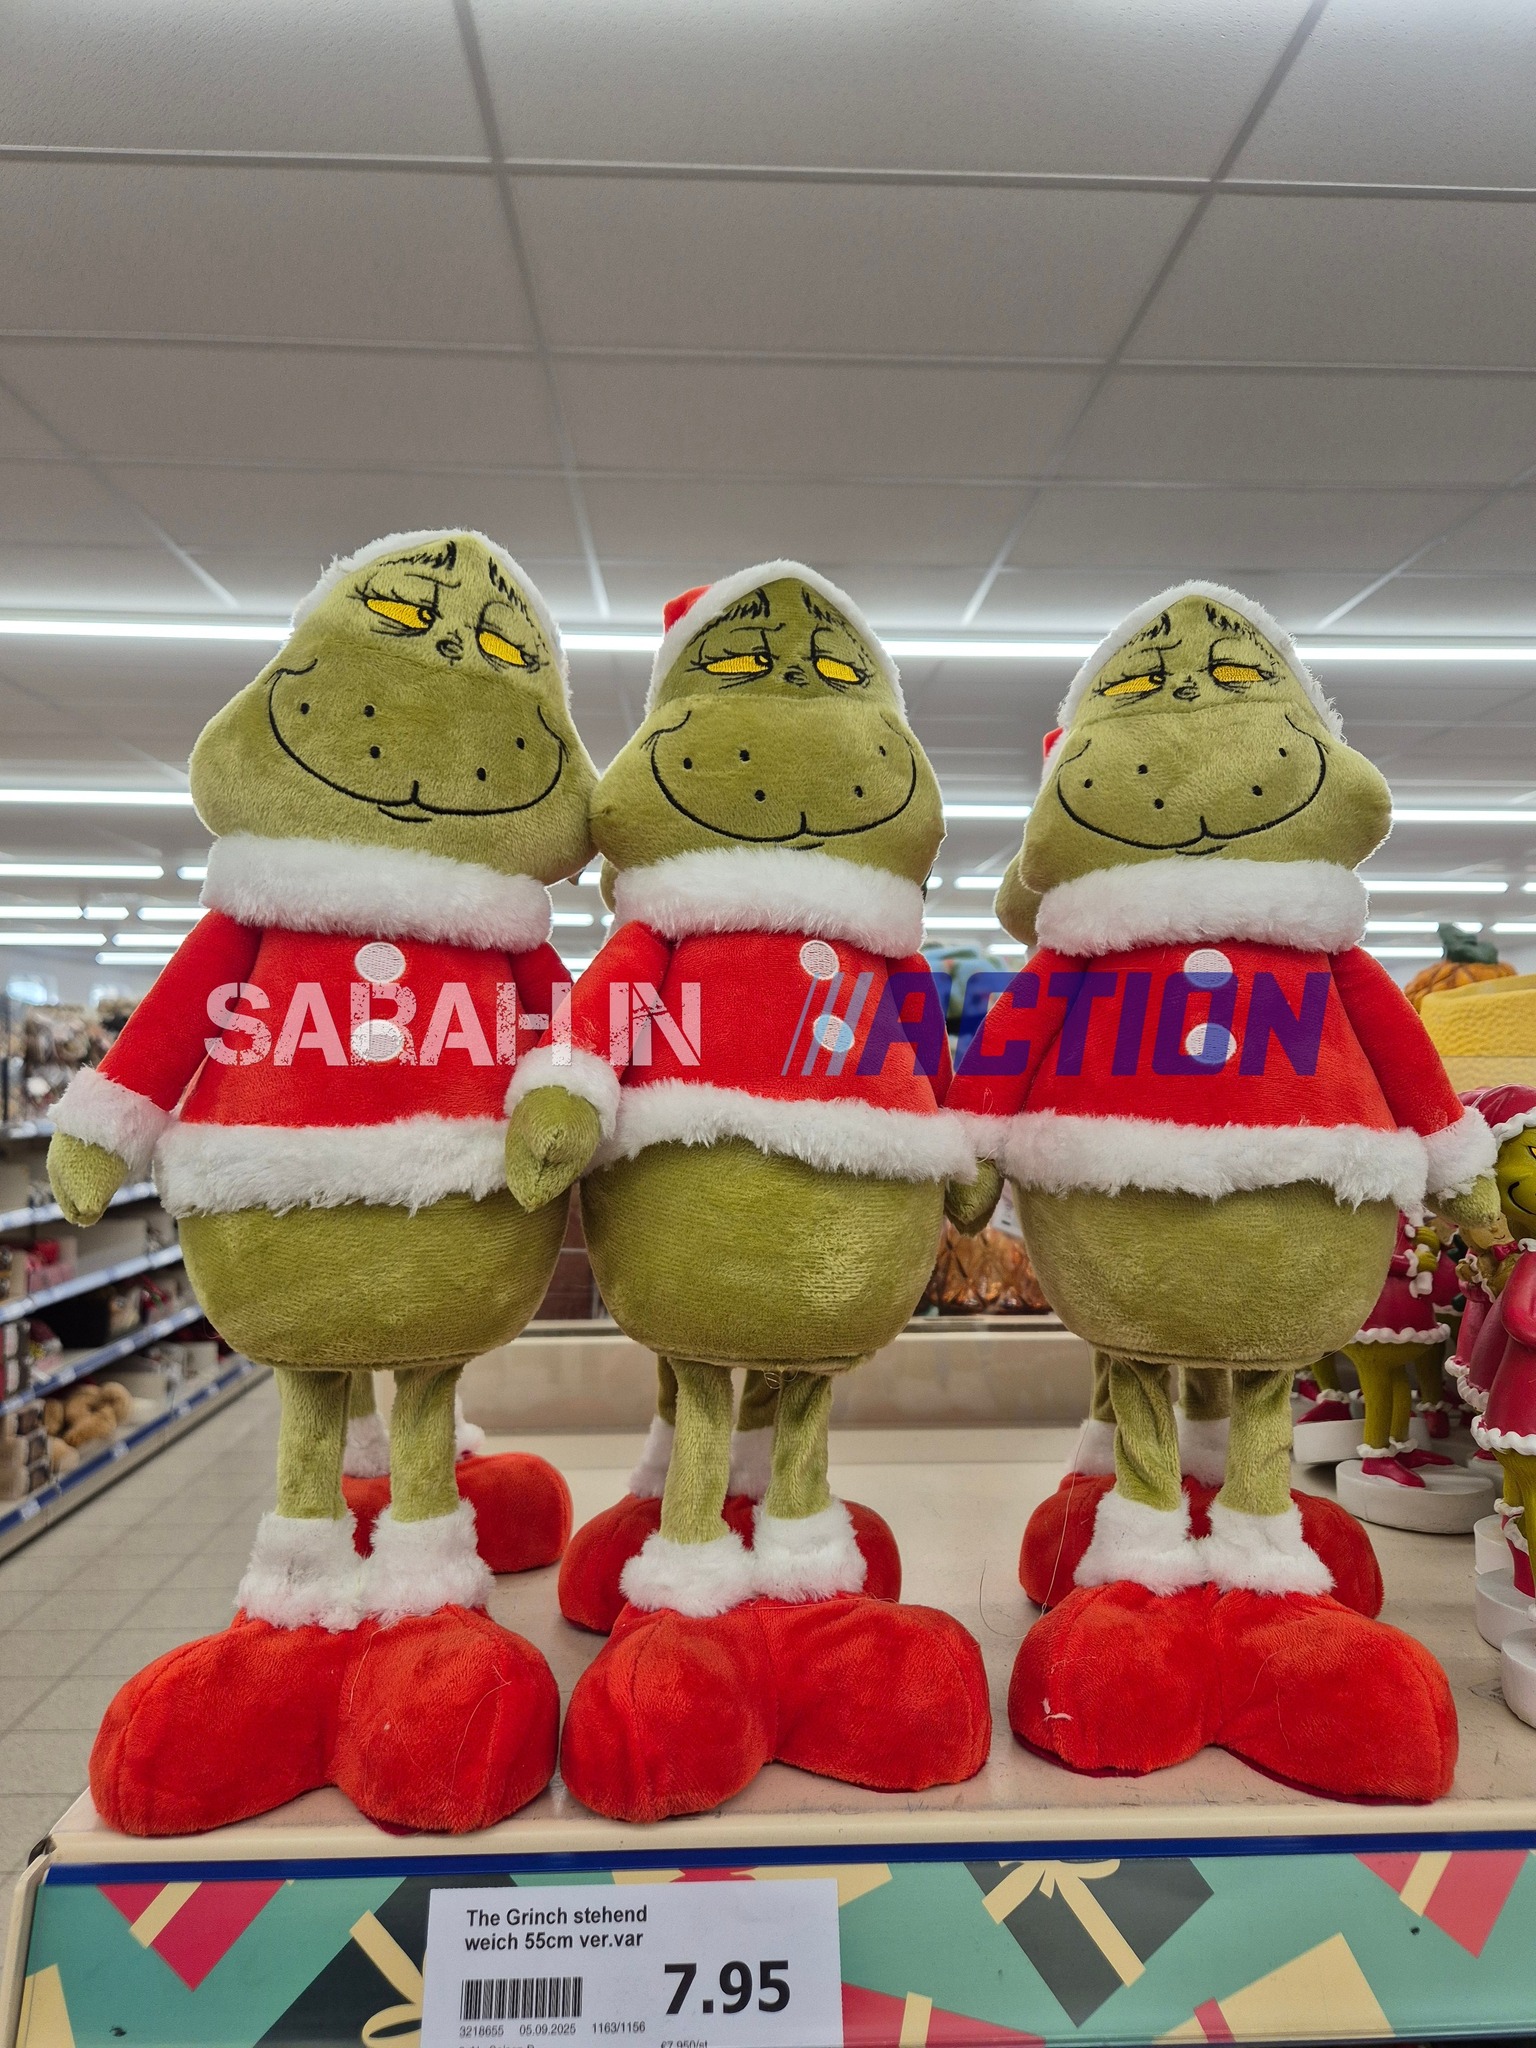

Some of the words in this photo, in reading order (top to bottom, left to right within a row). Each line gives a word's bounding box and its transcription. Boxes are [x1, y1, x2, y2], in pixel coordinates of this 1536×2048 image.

[466, 1908, 500, 1927] The
[506, 1907, 568, 1926] Grinch
[574, 1904, 648, 1924] stehend
[464, 1932, 519, 1951] weich
[524, 1932, 573, 1949] 55cm
[579, 1932, 644, 1948] ver.var
[664, 1959, 791, 2015] 7.95
[459, 2025, 504, 2038] 3218655
[519, 2023, 577, 2036] 05.09.2025
[592, 2021, 646, 2034] 1163/1156
